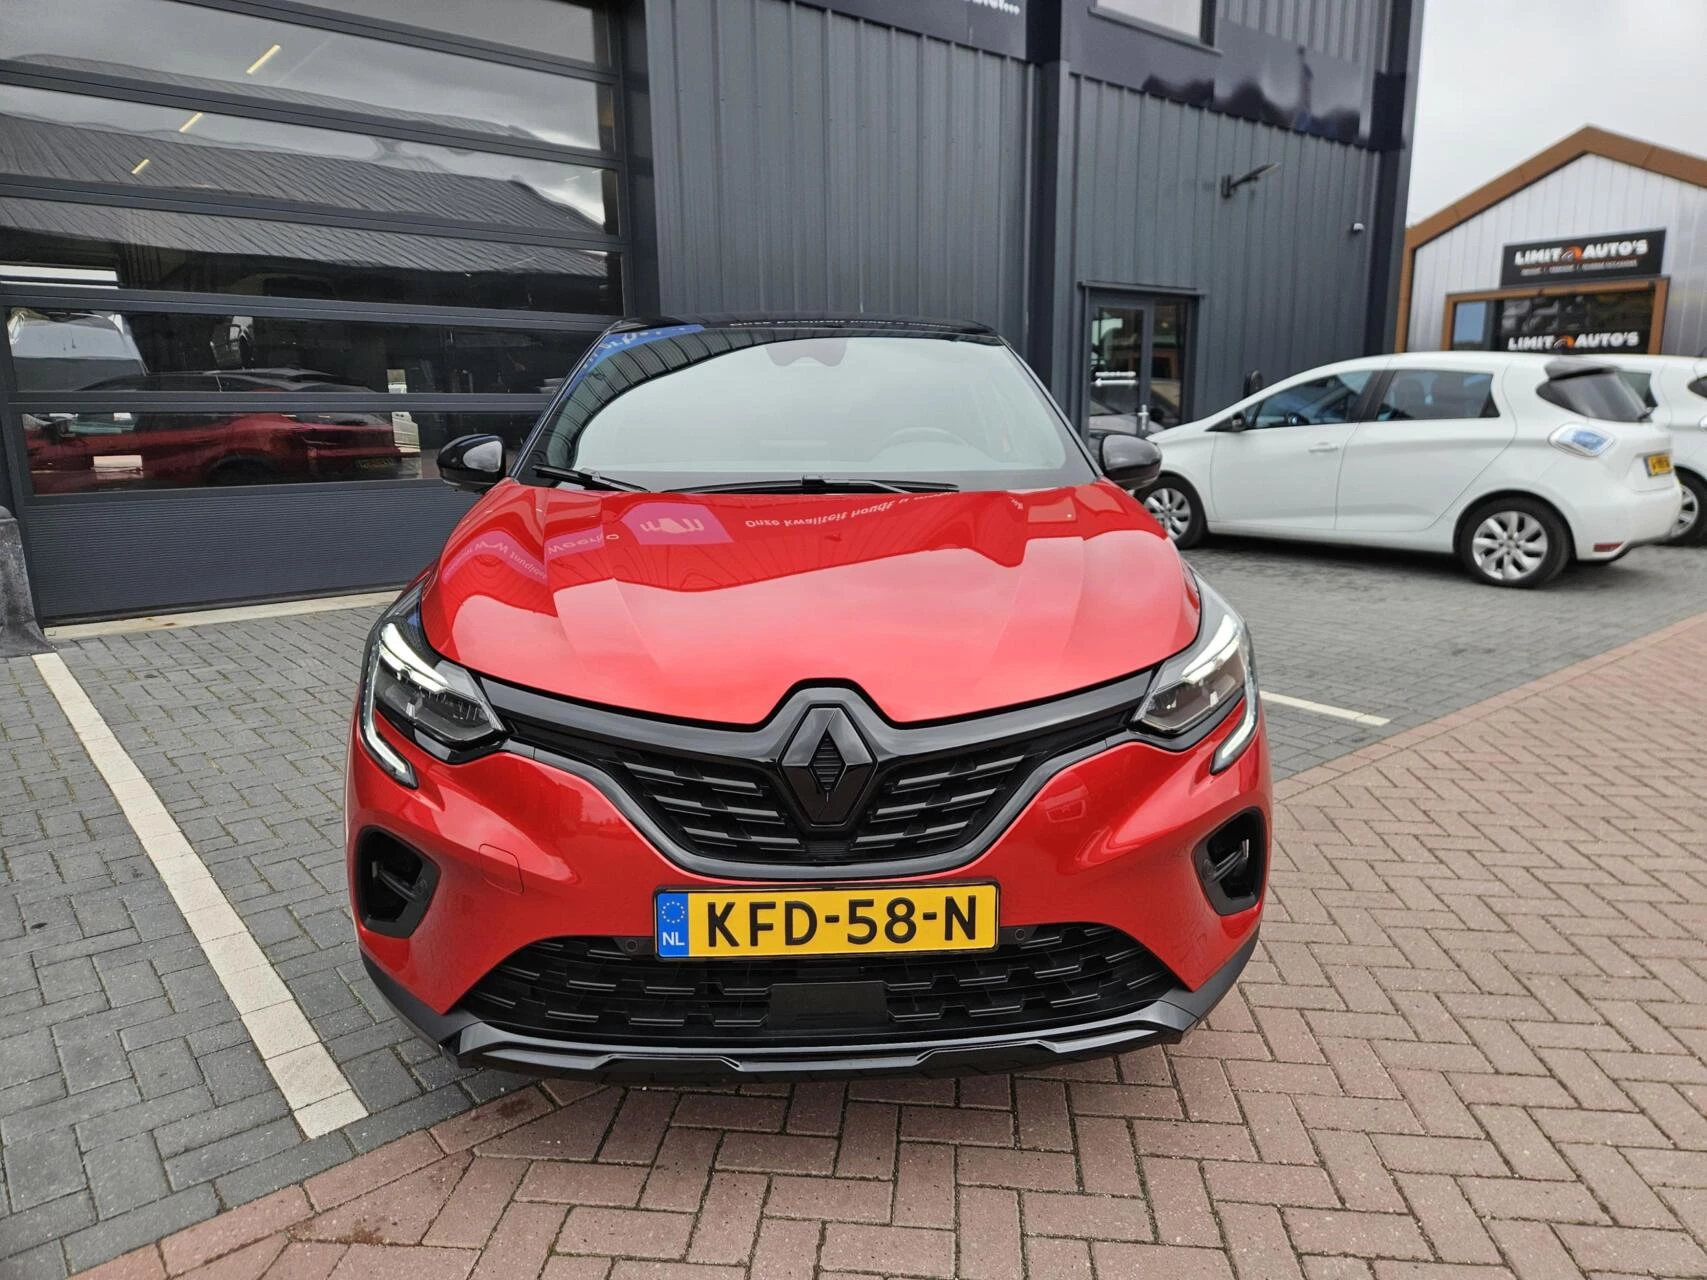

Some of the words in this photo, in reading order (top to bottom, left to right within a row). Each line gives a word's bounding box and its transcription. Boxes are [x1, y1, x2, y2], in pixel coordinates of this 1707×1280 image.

[1514, 247, 1563, 265] LIMIT
[1582, 239, 1648, 259] AUTO'S
[1508, 335, 1555, 350] LIMIT
[1574, 331, 1639, 348] AUTO'S
[707, 895, 977, 947] KFD-58-N
[662, 933, 685, 946] NL
